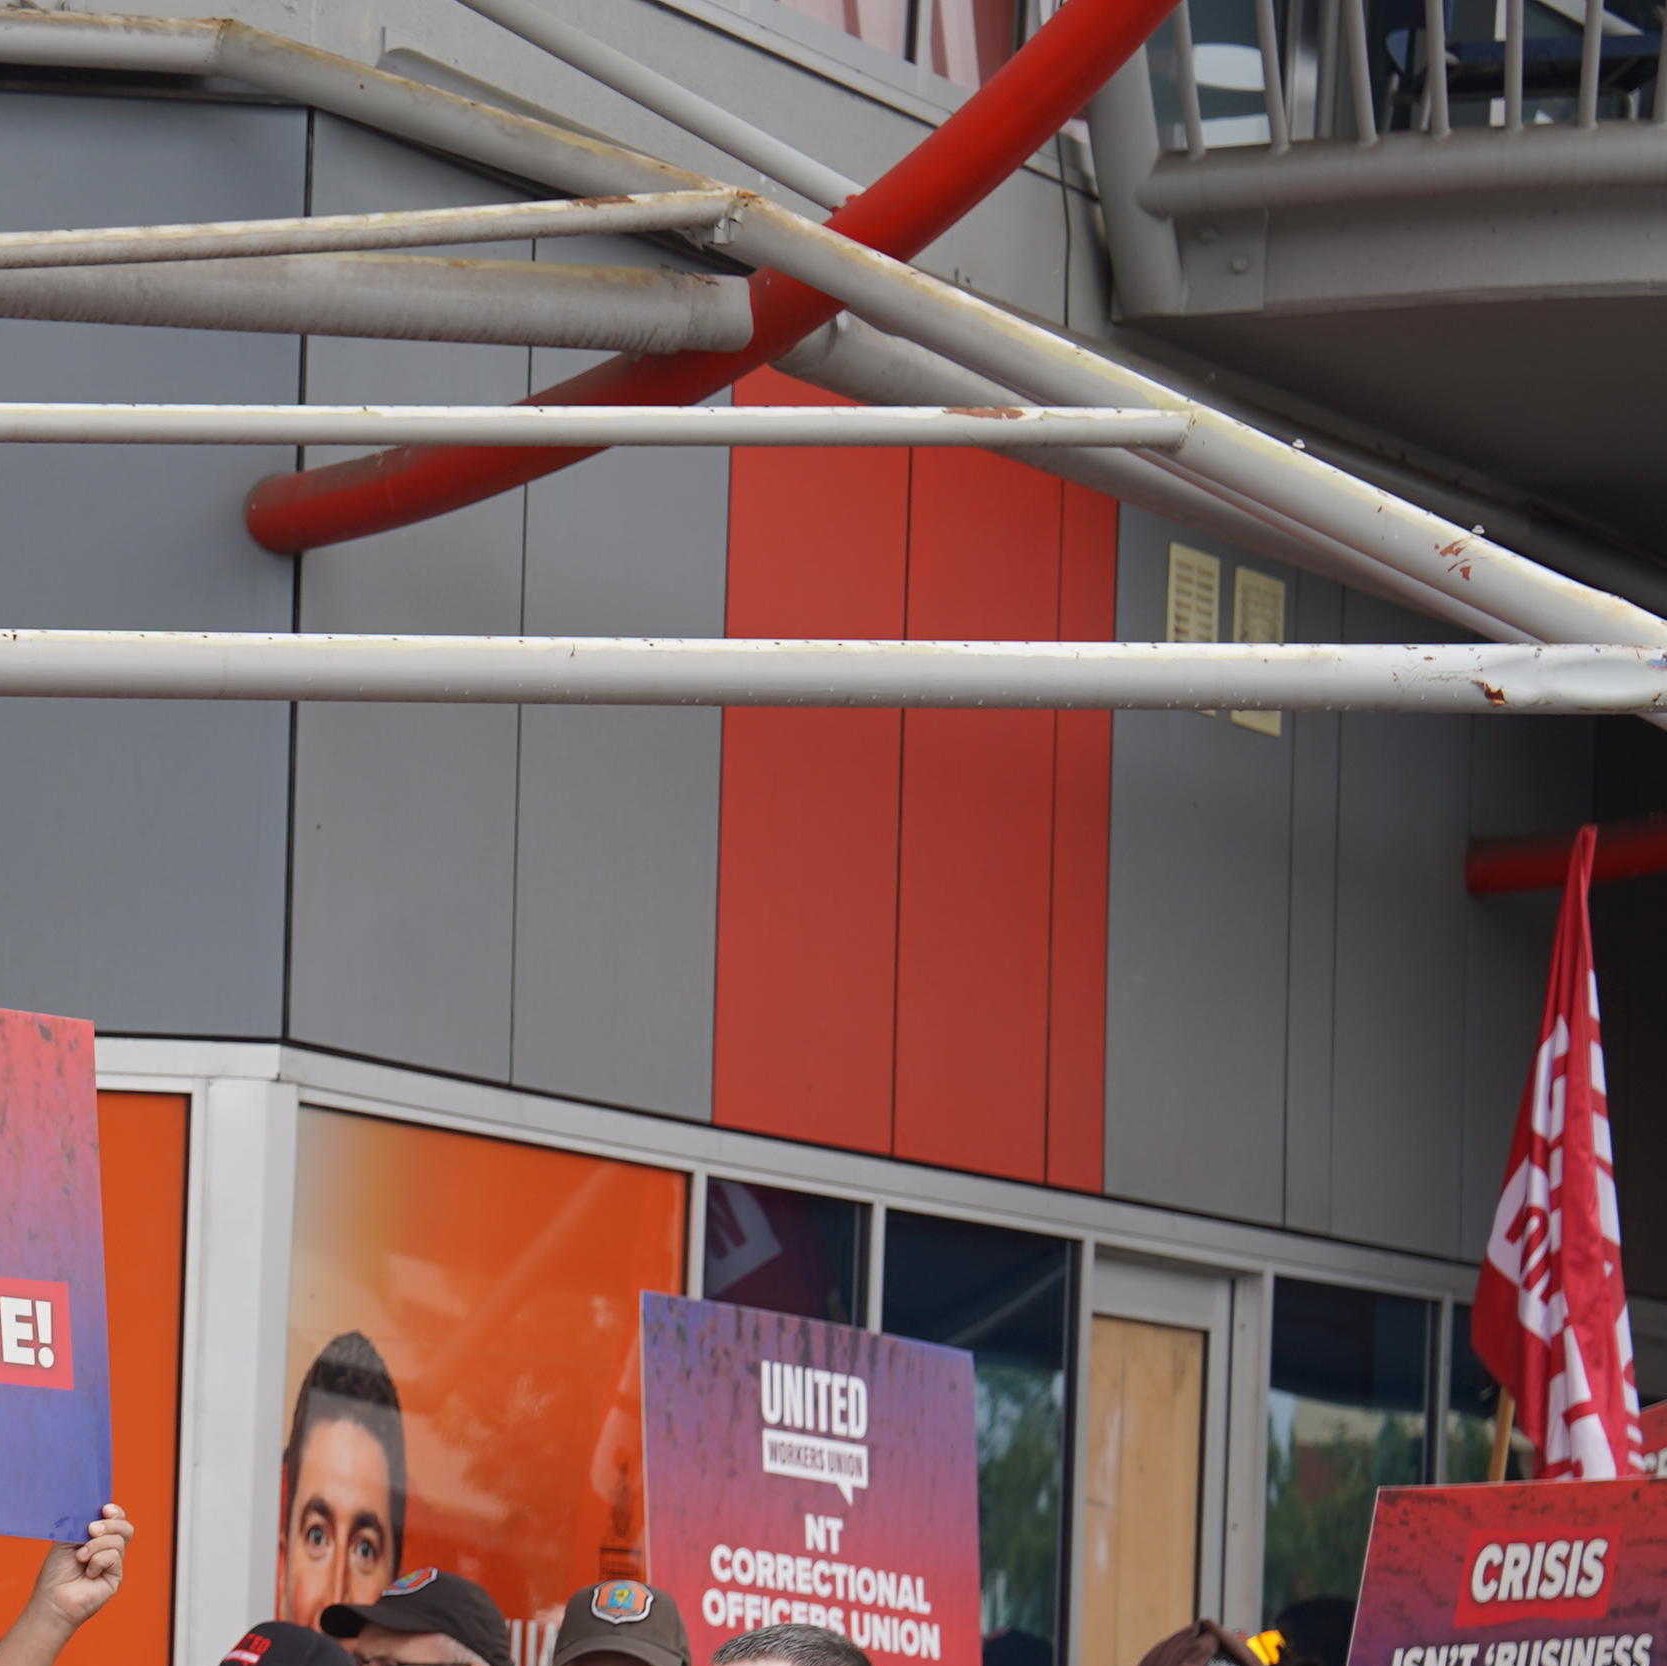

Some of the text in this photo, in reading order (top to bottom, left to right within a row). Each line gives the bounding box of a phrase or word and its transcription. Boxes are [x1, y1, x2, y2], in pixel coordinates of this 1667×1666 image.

[762, 1361, 867, 1438] UNITED
[768, 1438, 863, 1479] WORKERS UNION
[805, 1514, 843, 1553] NT
[710, 1545, 931, 1614] CORRECTIONAL
[1472, 1539, 1607, 1602] CRISIS
[851, 1611, 940, 1660] UNION
